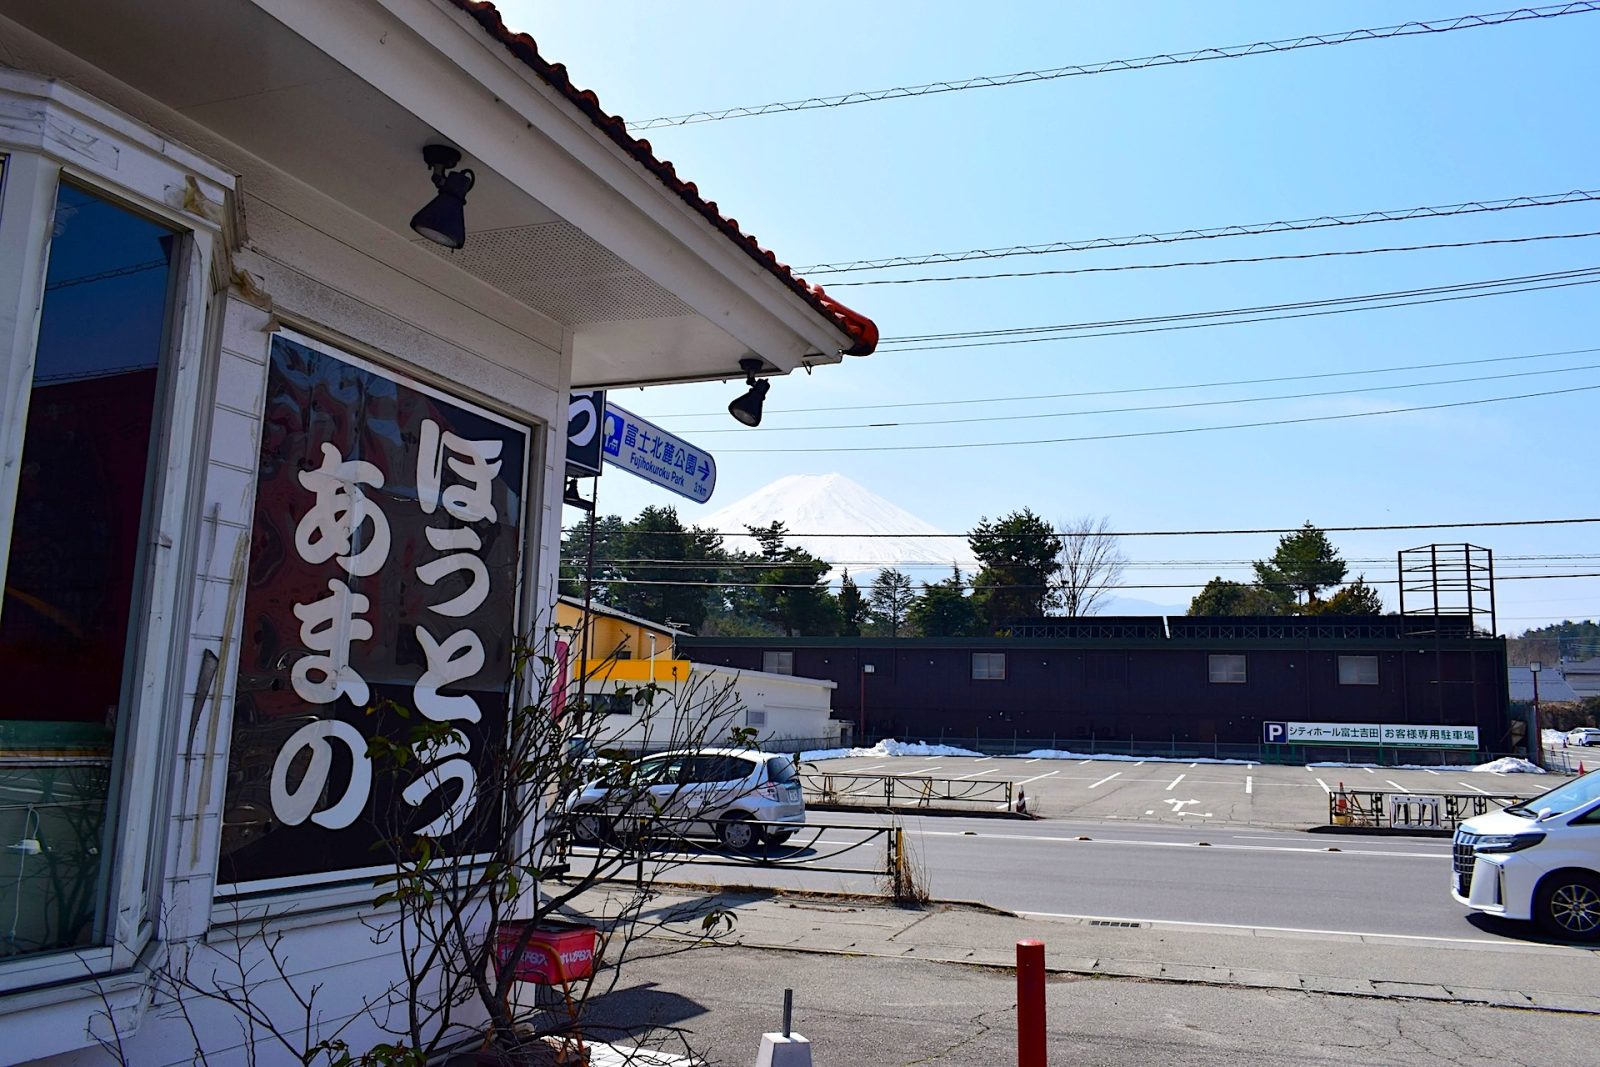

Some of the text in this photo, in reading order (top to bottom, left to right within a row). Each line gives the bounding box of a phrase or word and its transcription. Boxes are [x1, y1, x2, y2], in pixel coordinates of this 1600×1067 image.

[624, 423, 698, 477] 富士北麓公園
[630, 452, 685, 488] Fujihokuroku Park
[269, 441, 391, 830] あまの
[402, 418, 502, 837] ほうとう
[1269, 724, 1475, 741] P シティホール富士吉田 お客様専用駐車場
